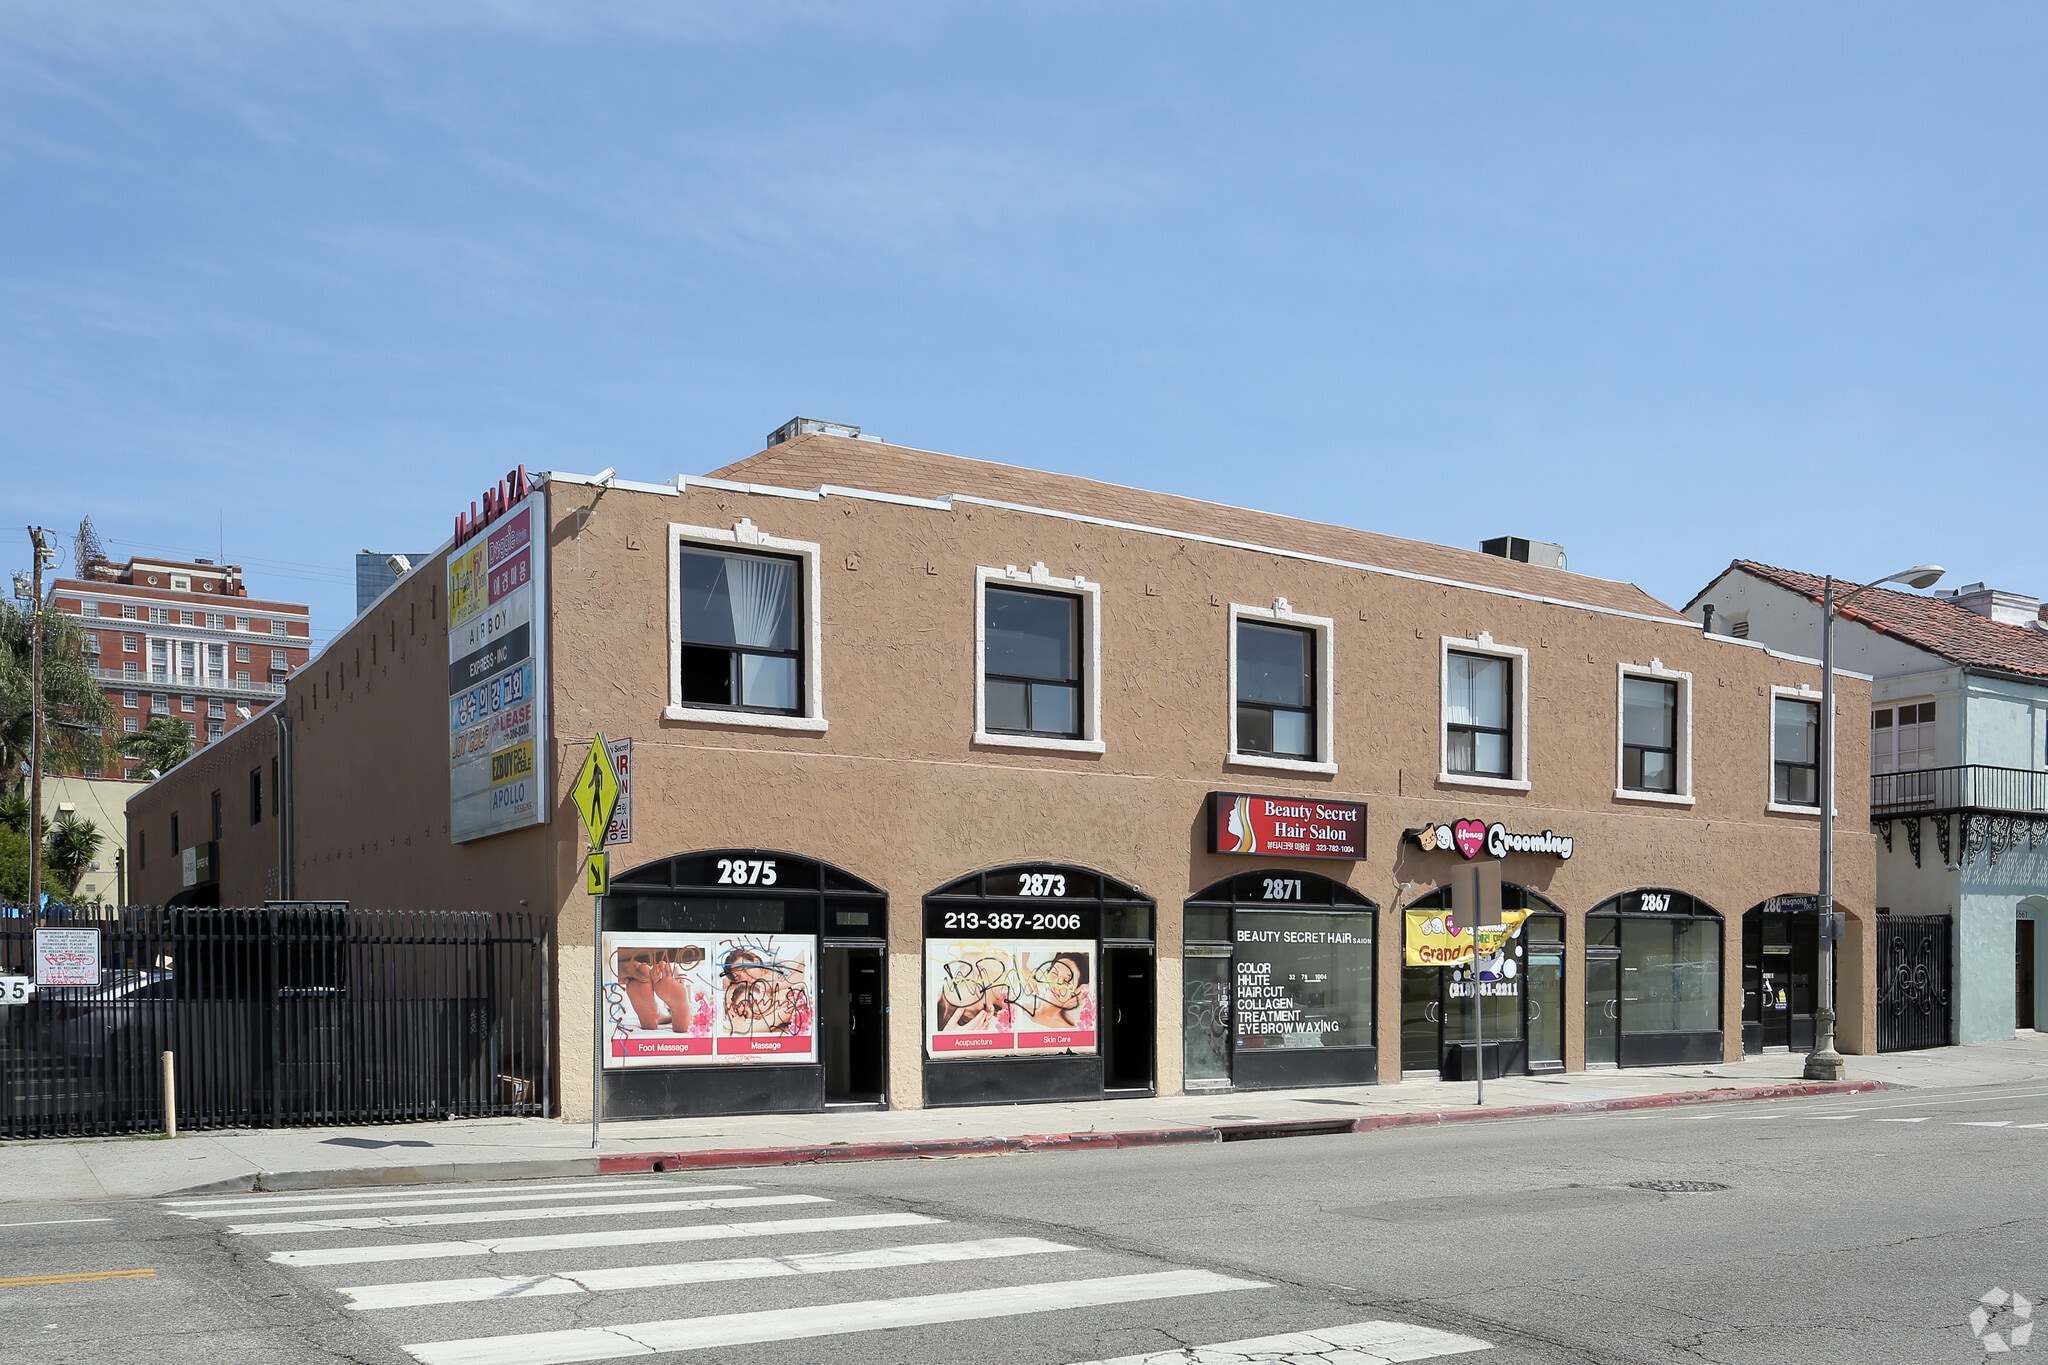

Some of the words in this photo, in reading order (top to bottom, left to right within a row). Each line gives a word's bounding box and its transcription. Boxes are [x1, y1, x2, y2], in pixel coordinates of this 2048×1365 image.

[483, 464, 527, 527] PLAZA
[469, 609, 507, 645] AIRBOY
[500, 704, 531, 731] LEASE
[493, 783, 524, 810] APOLLO
[1265, 800, 1312, 822] Beauty
[1316, 804, 1357, 821] Secret
[1275, 822, 1306, 839] Hair
[1310, 824, 1346, 841] Salon
[1316, 844, 1354, 853] 323-782-1004
[1457, 829, 1484, 840] Honey
[1488, 823, 1574, 859] Grooming
[717, 859, 777, 885] 2875
[1019, 873, 1066, 897] 2873
[1263, 879, 1301, 900] 2871
[1641, 893, 1671, 911] 2867
[1782, 898, 1807, 907] Magnolia
[944, 912, 1081, 930] 213-387-2006
[1237, 930, 1281, 942] BEAUTY
[1283, 931, 1325, 943] SECRET
[1420, 945, 1460, 962] Grand
[1237, 963, 1271, 974] COLOR
[1263, 986, 1284, 997] CUT
[1237, 998, 1293, 1010] COLLAGEN
[1238, 1010, 1301, 1022] TREATMENT
[638, 1044, 655, 1052] Foot
[657, 1043, 689, 1053] Massage
[751, 1041, 781, 1051] Massage
[955, 1038, 993, 1047] Acupuncture
